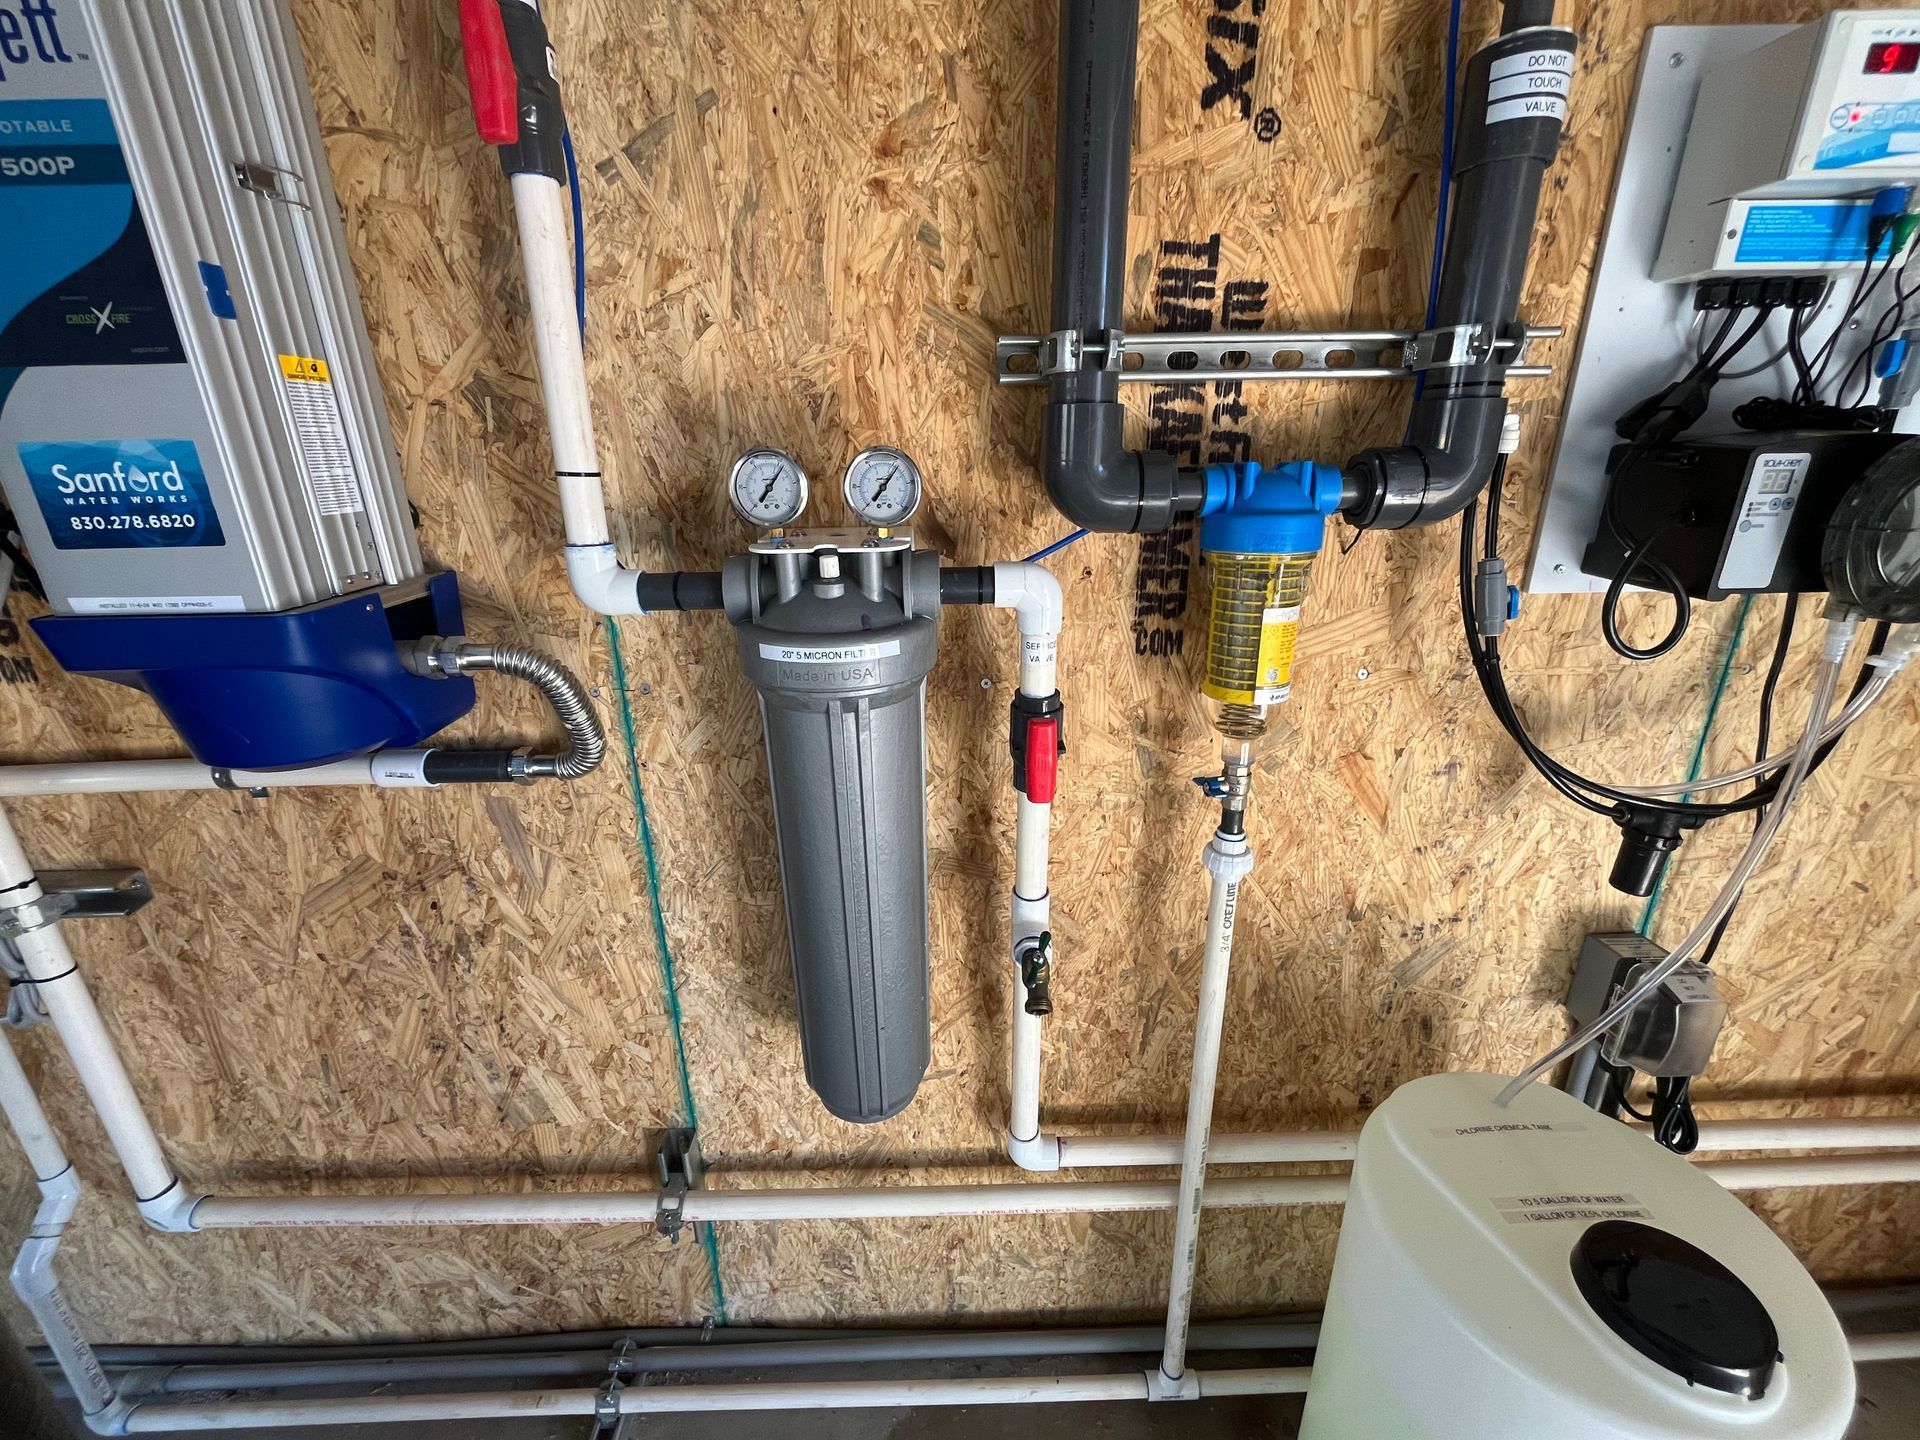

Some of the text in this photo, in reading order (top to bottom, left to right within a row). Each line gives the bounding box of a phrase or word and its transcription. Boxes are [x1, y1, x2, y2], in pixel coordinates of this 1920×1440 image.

[1528, 54, 1567, 67] DO NOT
[1528, 77, 1563, 88] TOUCH
[1525, 101, 1557, 112] VALVE
[52, 461, 184, 494] Sanford
[63, 495, 188, 506] WATER WORKS
[71, 514, 195, 530] 830.278.6820
[1025, 641, 1057, 650] SERICE
[796, 650, 802, 659] 5
[804, 651, 841, 660] MICRON
[844, 648, 877, 659] FILTR
[1029, 654, 1054, 663] VAVE
[783, 668, 874, 681] Made in USA
[1456, 1123, 1552, 1136] CHLORINE CHEMICAL TANK
[1518, 1198, 1533, 1206] TO
[1541, 1195, 1581, 1205] GALLONS
[1582, 1196, 1594, 1204] OF
[1593, 1195, 1625, 1203] WATER
[1530, 1211, 1564, 1221] GALLON
[1565, 1211, 1577, 1219] OF
[1600, 1209, 1643, 1219] CHLORINE
